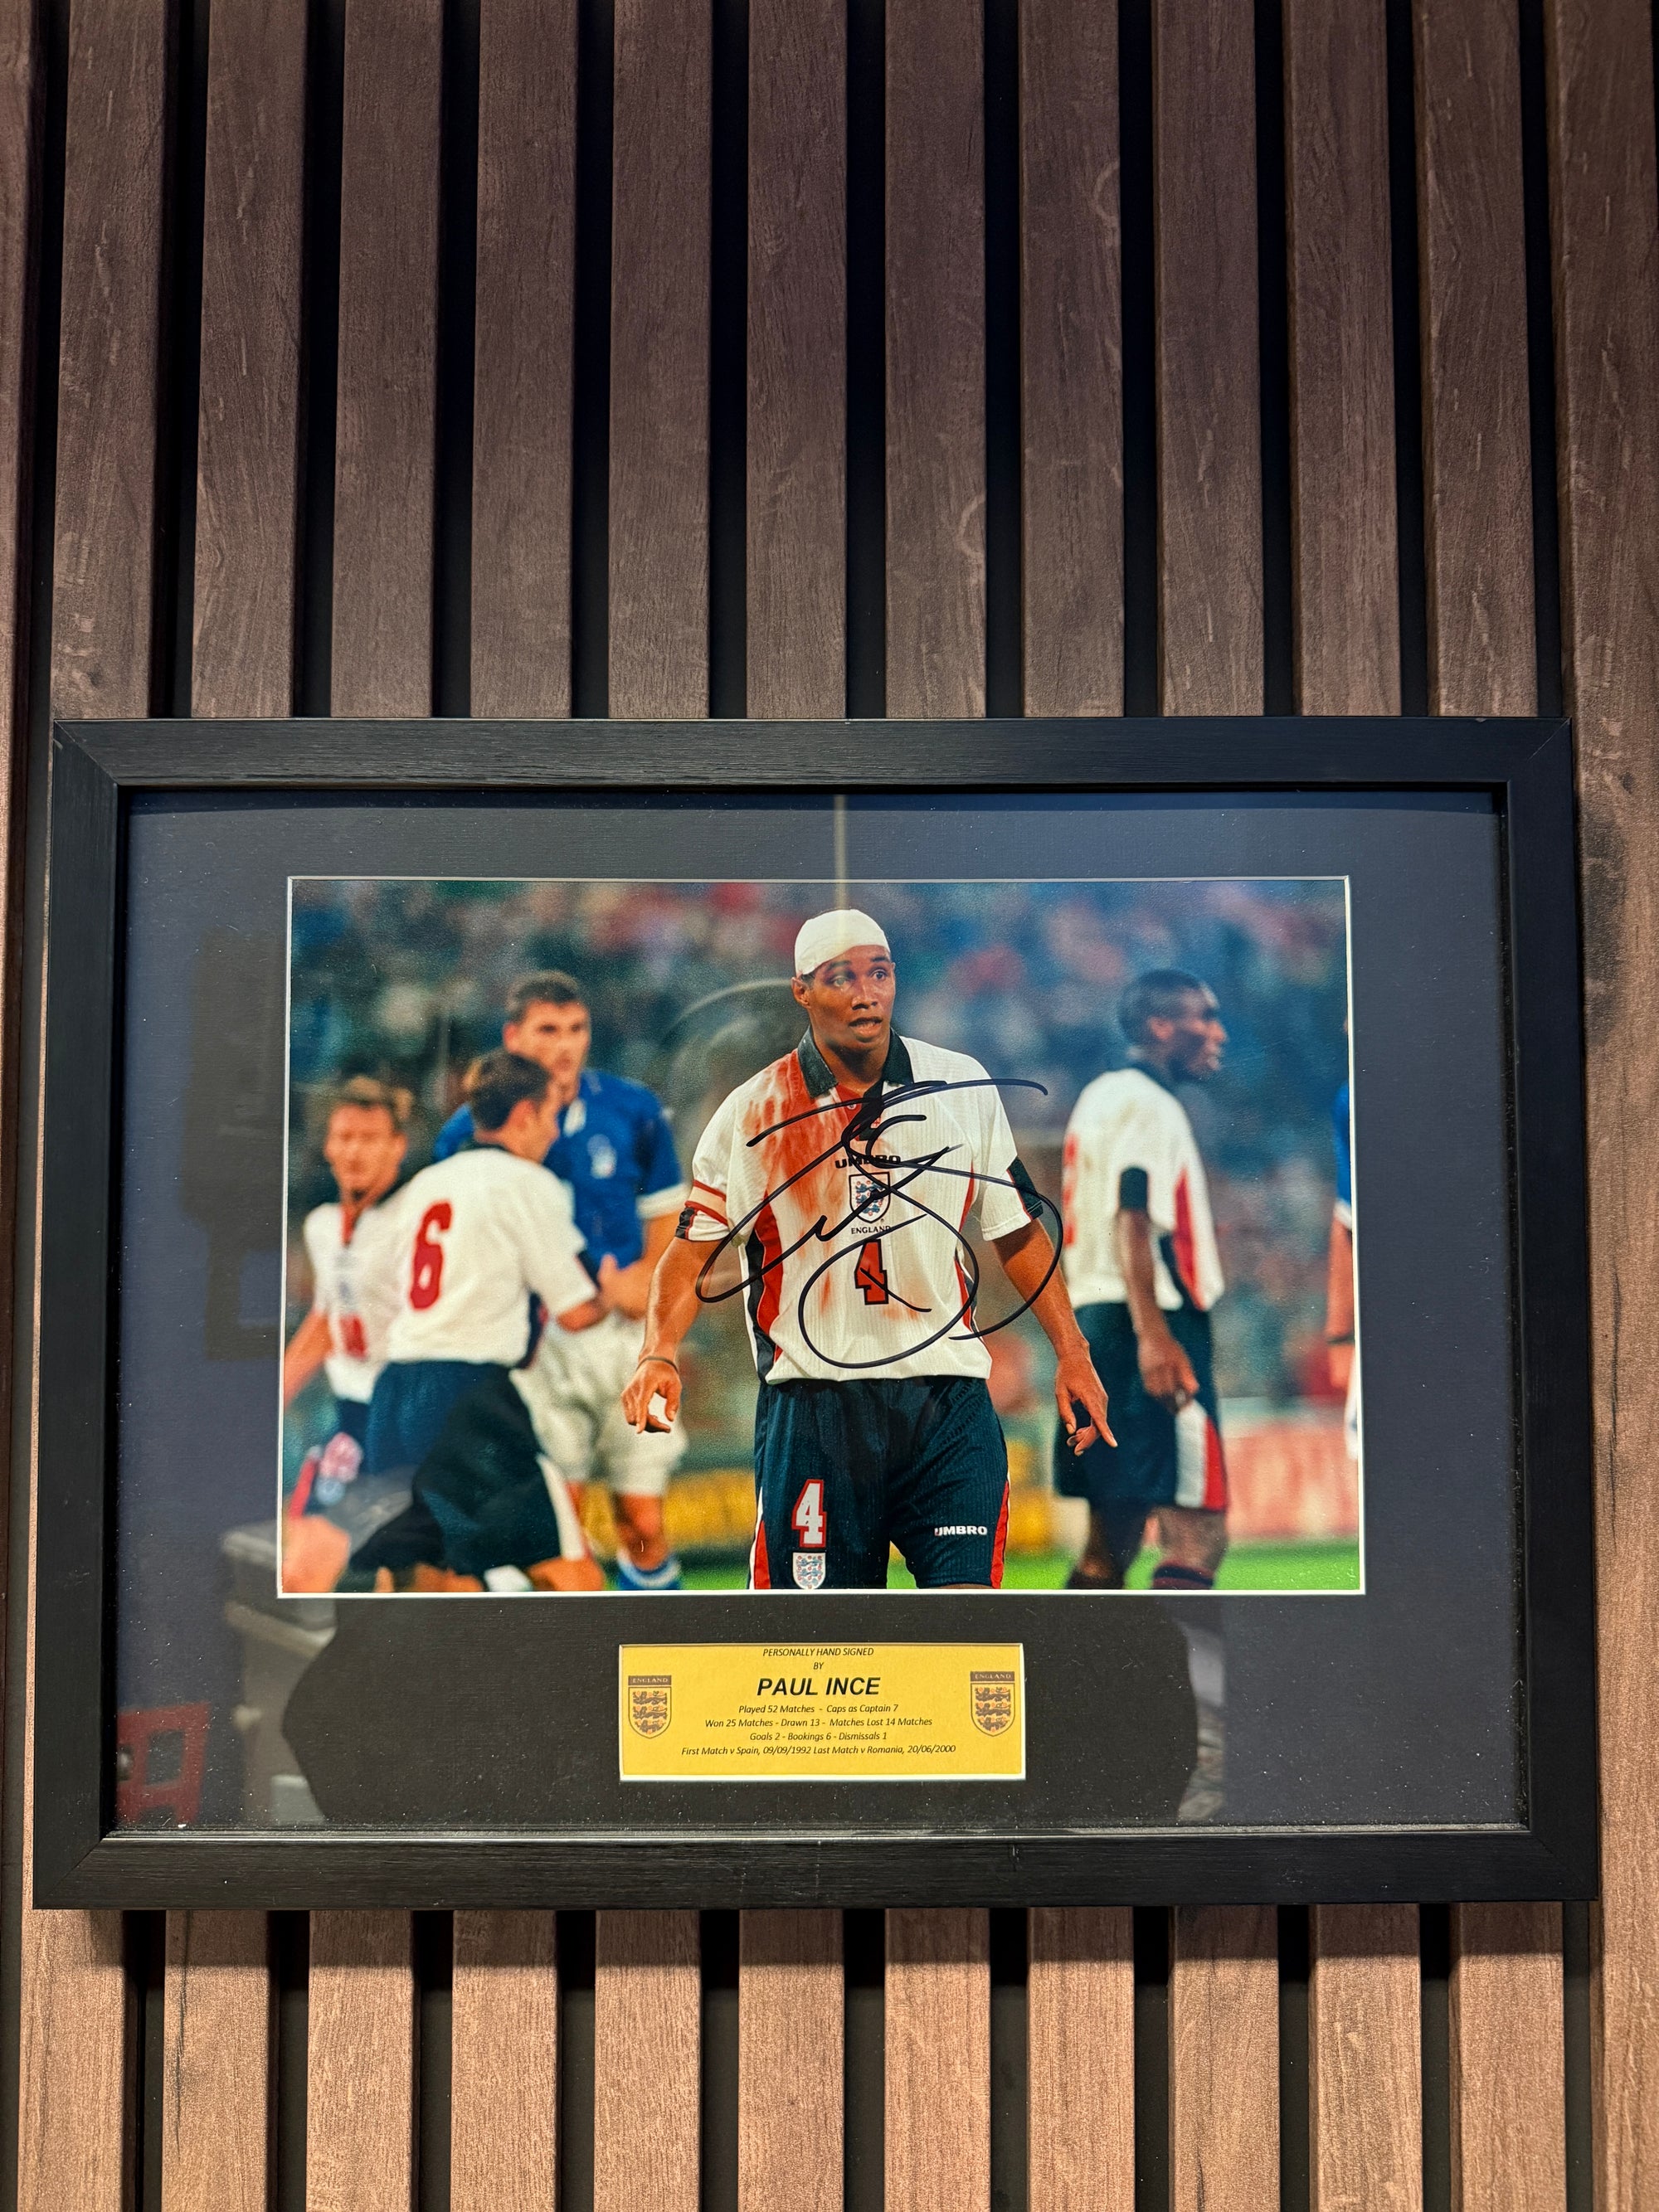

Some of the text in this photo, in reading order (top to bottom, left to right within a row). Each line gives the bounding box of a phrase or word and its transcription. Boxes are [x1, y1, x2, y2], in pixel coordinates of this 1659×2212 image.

[410, 1199, 453, 1310] 6
[854, 1238, 889, 1305] 4
[791, 1479, 827, 1548] 4
[935, 1525, 988, 1537] UMBRO
[762, 1647, 874, 1657] PERSONALLY HAND SIGNED
[813, 1661, 825, 1670] BY
[757, 1676, 881, 1696] PAUL INCE
[738, 1704, 766, 1714] Played
[767, 1704, 778, 1714] 52
[780, 1704, 815, 1714] Matches
[826, 1704, 846, 1714] Caps
[859, 1704, 891, 1714] Captain
[893, 1704, 899, 1712] 7
[705, 1719, 724, 1728] Won
[725, 1719, 737, 1728] 25
[738, 1719, 774, 1728] Matches
[781, 1719, 808, 1727] Drawn
[810, 1719, 820, 1727] 13
[829, 1719, 864, 1727] Matches
[866, 1718, 883, 1726] Lost
[885, 1718, 896, 1726] 14
[898, 1717, 932, 1726] Matches
[749, 1732, 773, 1741] Goals
[775, 1732, 781, 1741] 2
[787, 1732, 824, 1742] Bookings
[825, 1732, 832, 1741] 6
[839, 1731, 880, 1741] Dismissals
[882, 1732, 887, 1740] 1
[681, 1747, 700, 1755] First
[701, 1746, 728, 1755] Match
[736, 1746, 761, 1756] Spain,
[762, 1745, 811, 1756] 09/09/1992
[813, 1746, 830, 1754] Last
[831, 1745, 859, 1754] Match
[867, 1745, 905, 1755] Romania,
[907, 1744, 956, 1754] 20/06/2000
